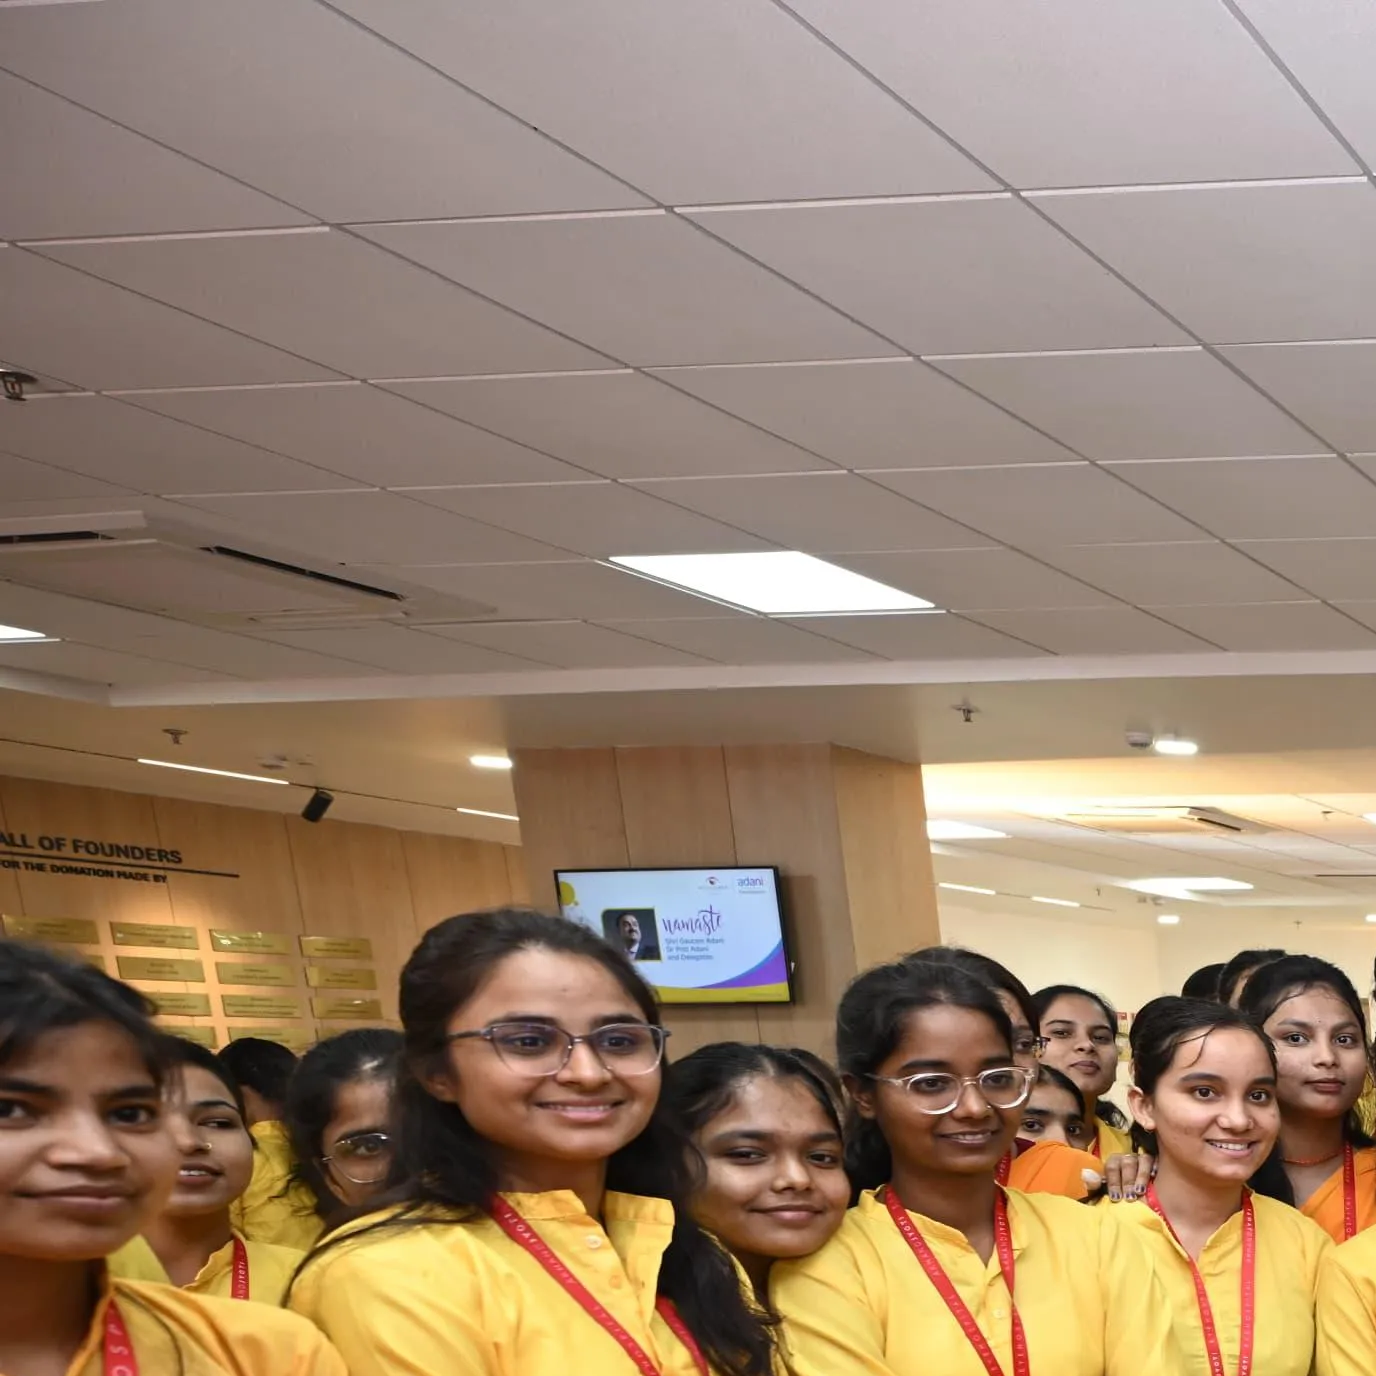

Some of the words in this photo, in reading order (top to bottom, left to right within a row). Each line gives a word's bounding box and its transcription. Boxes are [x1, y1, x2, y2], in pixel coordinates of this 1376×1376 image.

[39, 836, 67, 852] OF
[73, 839, 184, 864] FOUNDERS
[25, 861, 47, 873] THE
[51, 864, 114, 879] DONATION
[117, 871, 151, 882] MADE
[153, 874, 168, 884] BY
[738, 876, 764, 887] adani
[662, 904, 722, 935] namaste
